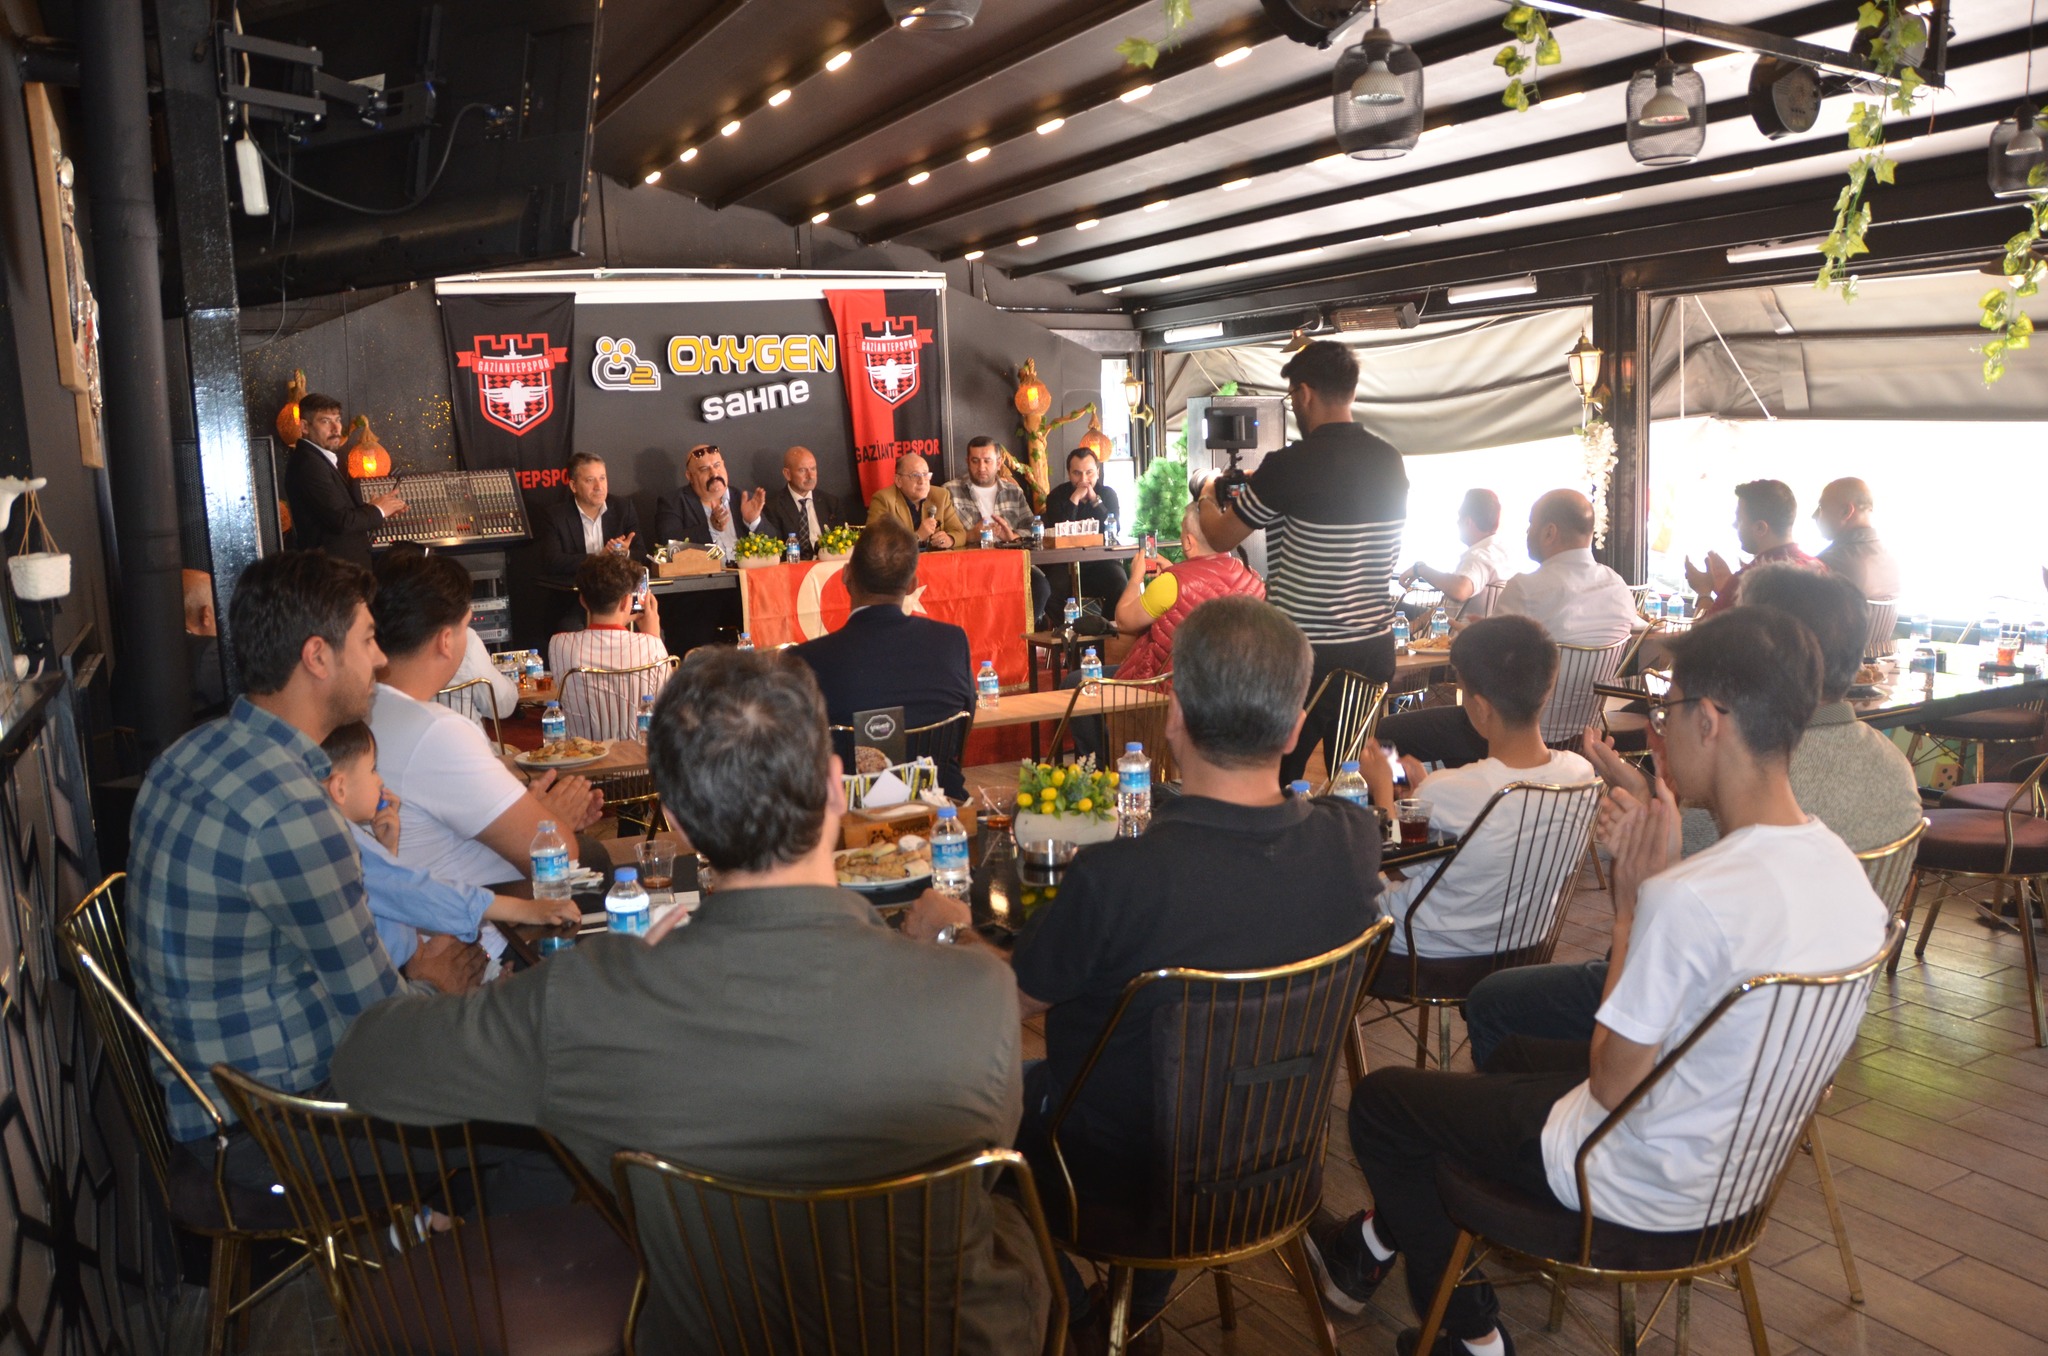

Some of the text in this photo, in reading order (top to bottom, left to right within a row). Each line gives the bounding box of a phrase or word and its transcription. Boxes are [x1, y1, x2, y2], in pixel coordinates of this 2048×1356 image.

[478, 358, 550, 373] GAZİANTEPSPOR
[668, 335, 836, 375] OXYGEN
[515, 468, 570, 489] TEPSPO
